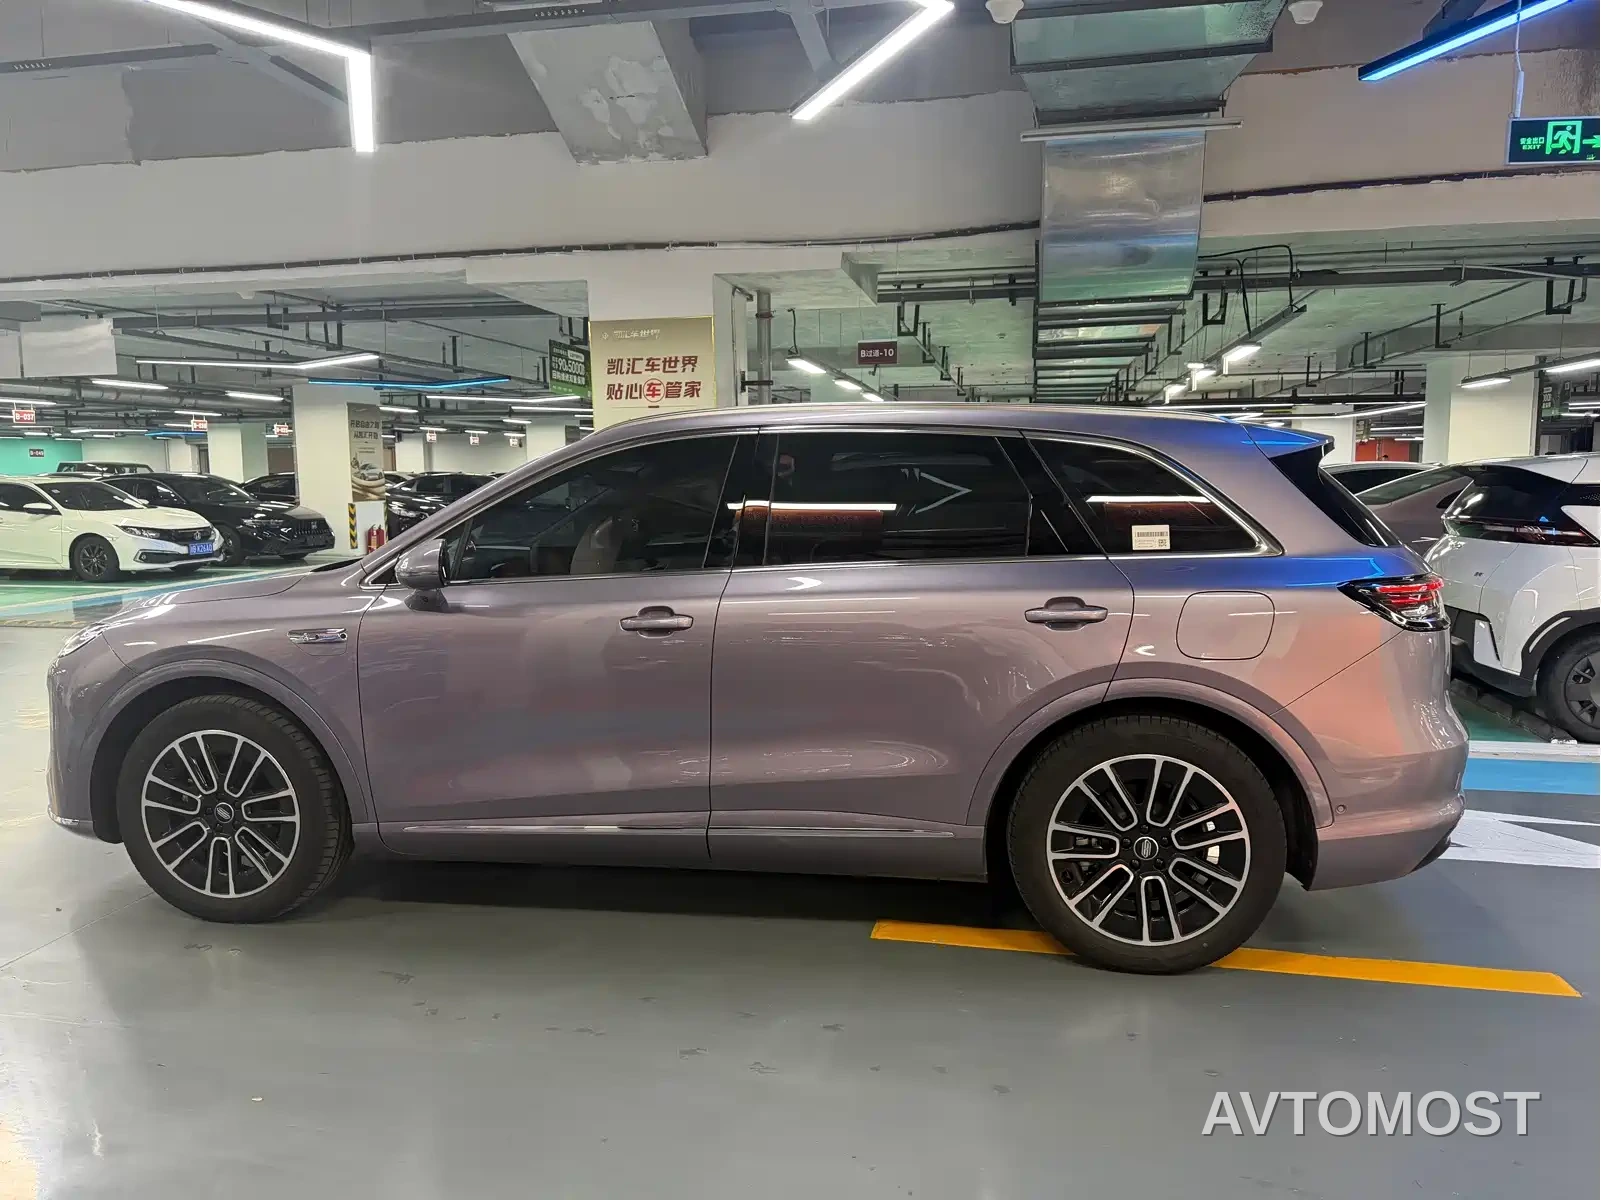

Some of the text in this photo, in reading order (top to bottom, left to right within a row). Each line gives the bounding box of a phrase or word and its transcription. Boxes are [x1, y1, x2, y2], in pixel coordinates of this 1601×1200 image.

[860, 348, 895, 358] B过道-10
[606, 355, 698, 375] 凯汇车世界
[606, 380, 702, 401] 贴心车管家
[15, 413, 34, 421] B-037
